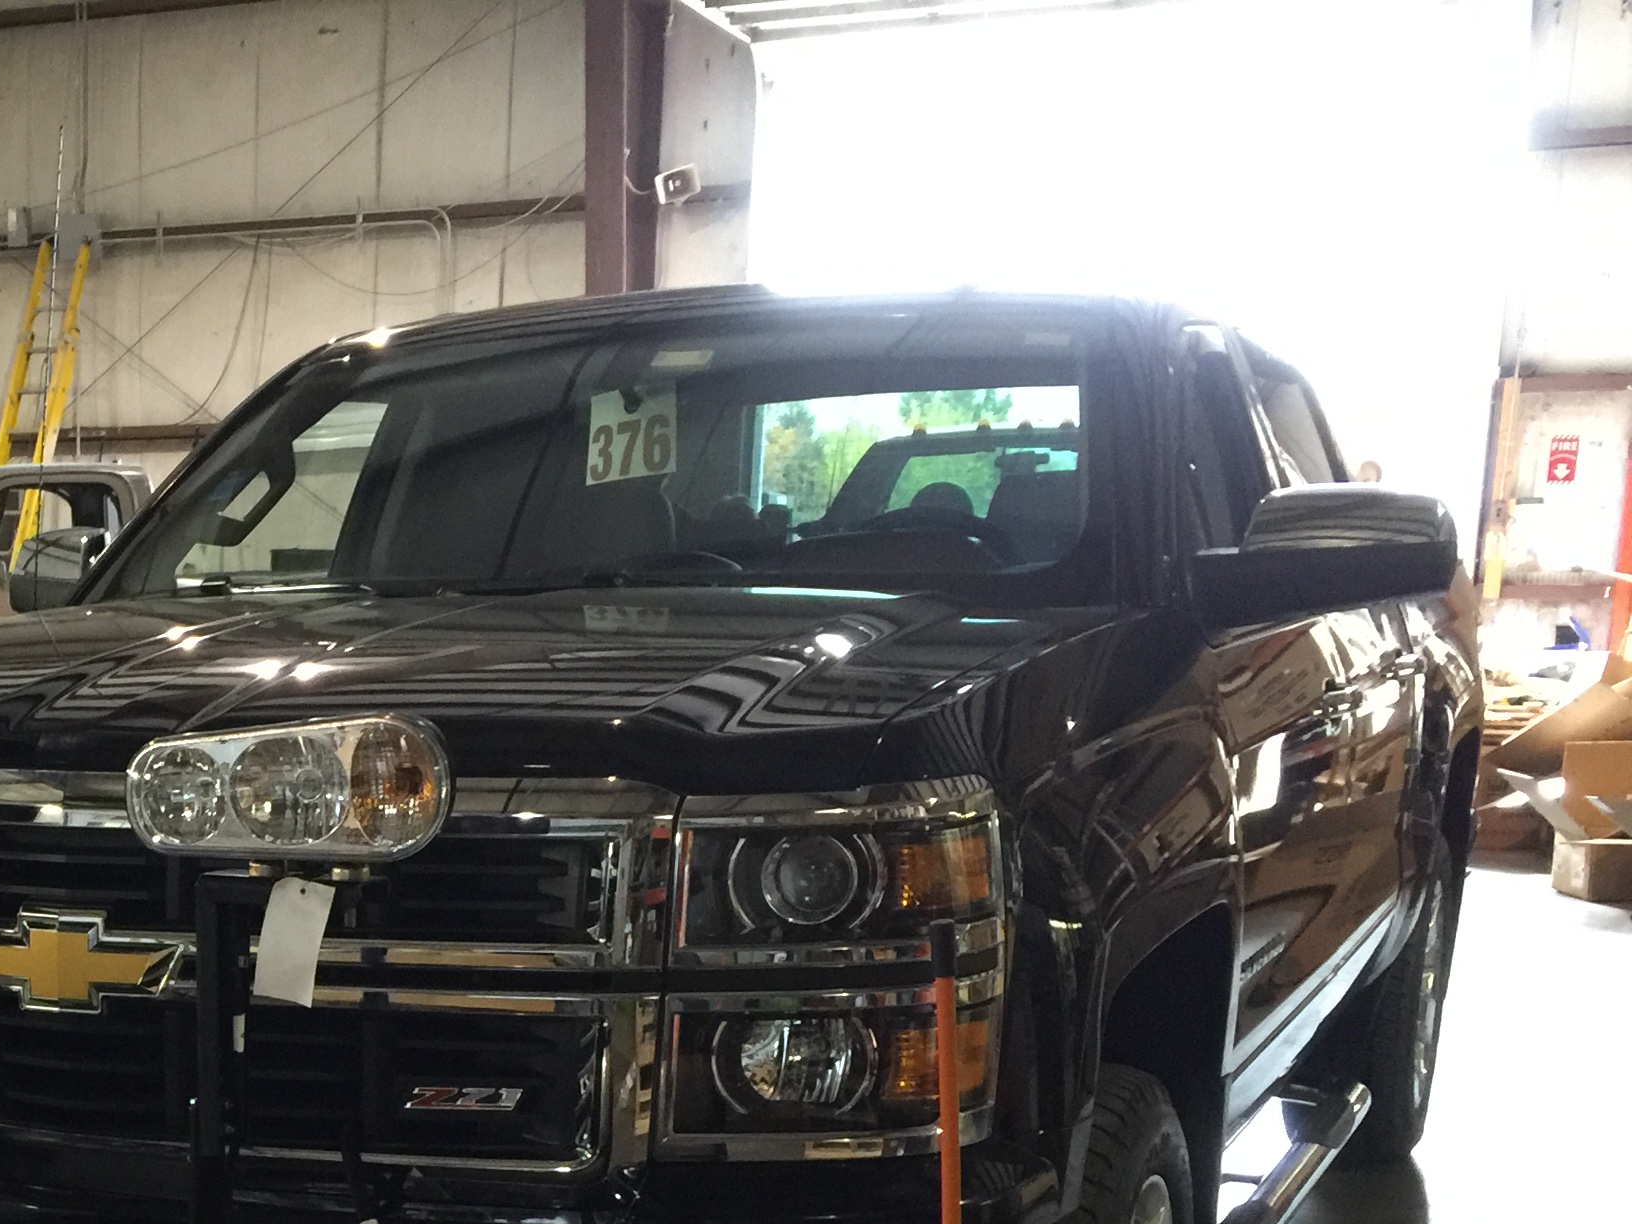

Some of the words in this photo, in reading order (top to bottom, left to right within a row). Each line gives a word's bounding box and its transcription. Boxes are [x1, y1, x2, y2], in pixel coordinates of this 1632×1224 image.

[590, 413, 672, 482] 376
[1551, 441, 1578, 451] FIRE
[404, 1087, 524, 1110] Z71
